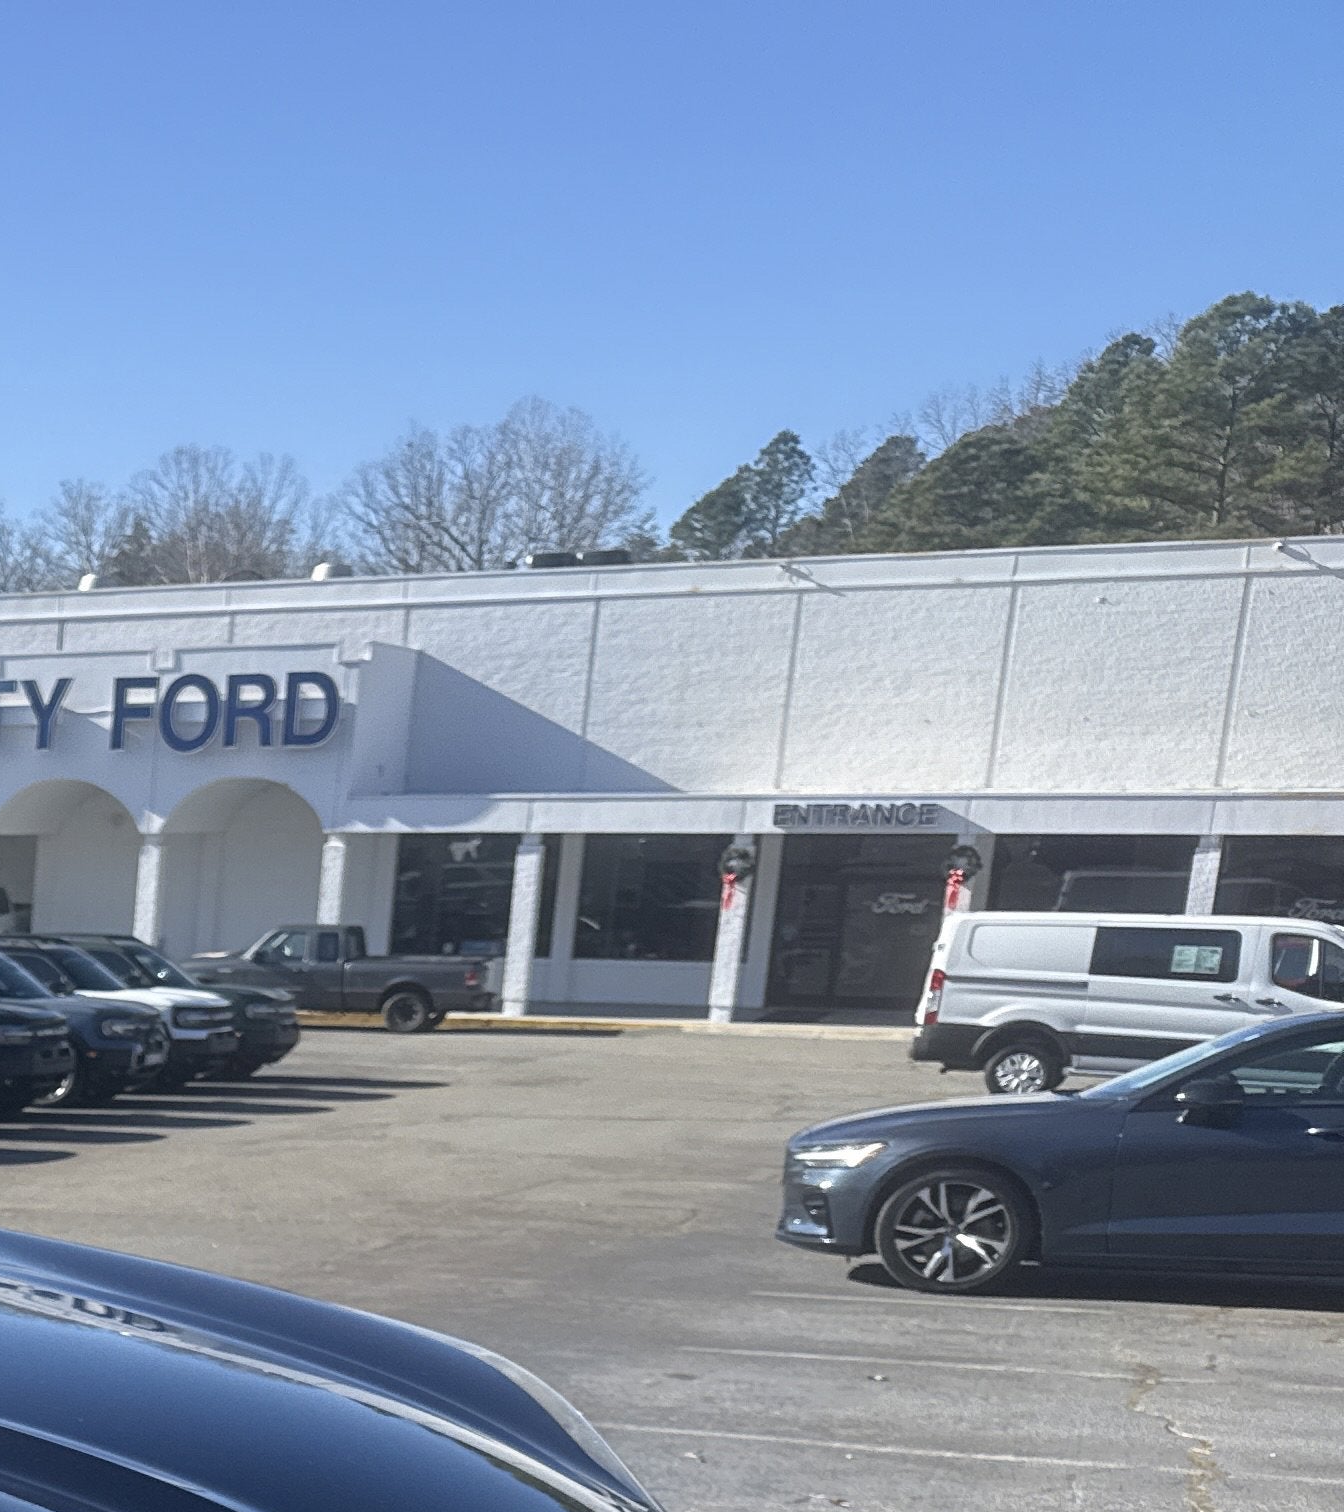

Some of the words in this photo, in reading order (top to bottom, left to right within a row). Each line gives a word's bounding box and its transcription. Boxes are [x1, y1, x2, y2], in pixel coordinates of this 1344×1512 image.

[111, 671, 340, 754] FORD
[773, 803, 939, 828] ENTRANCE
[871, 892, 930, 915] Ford
